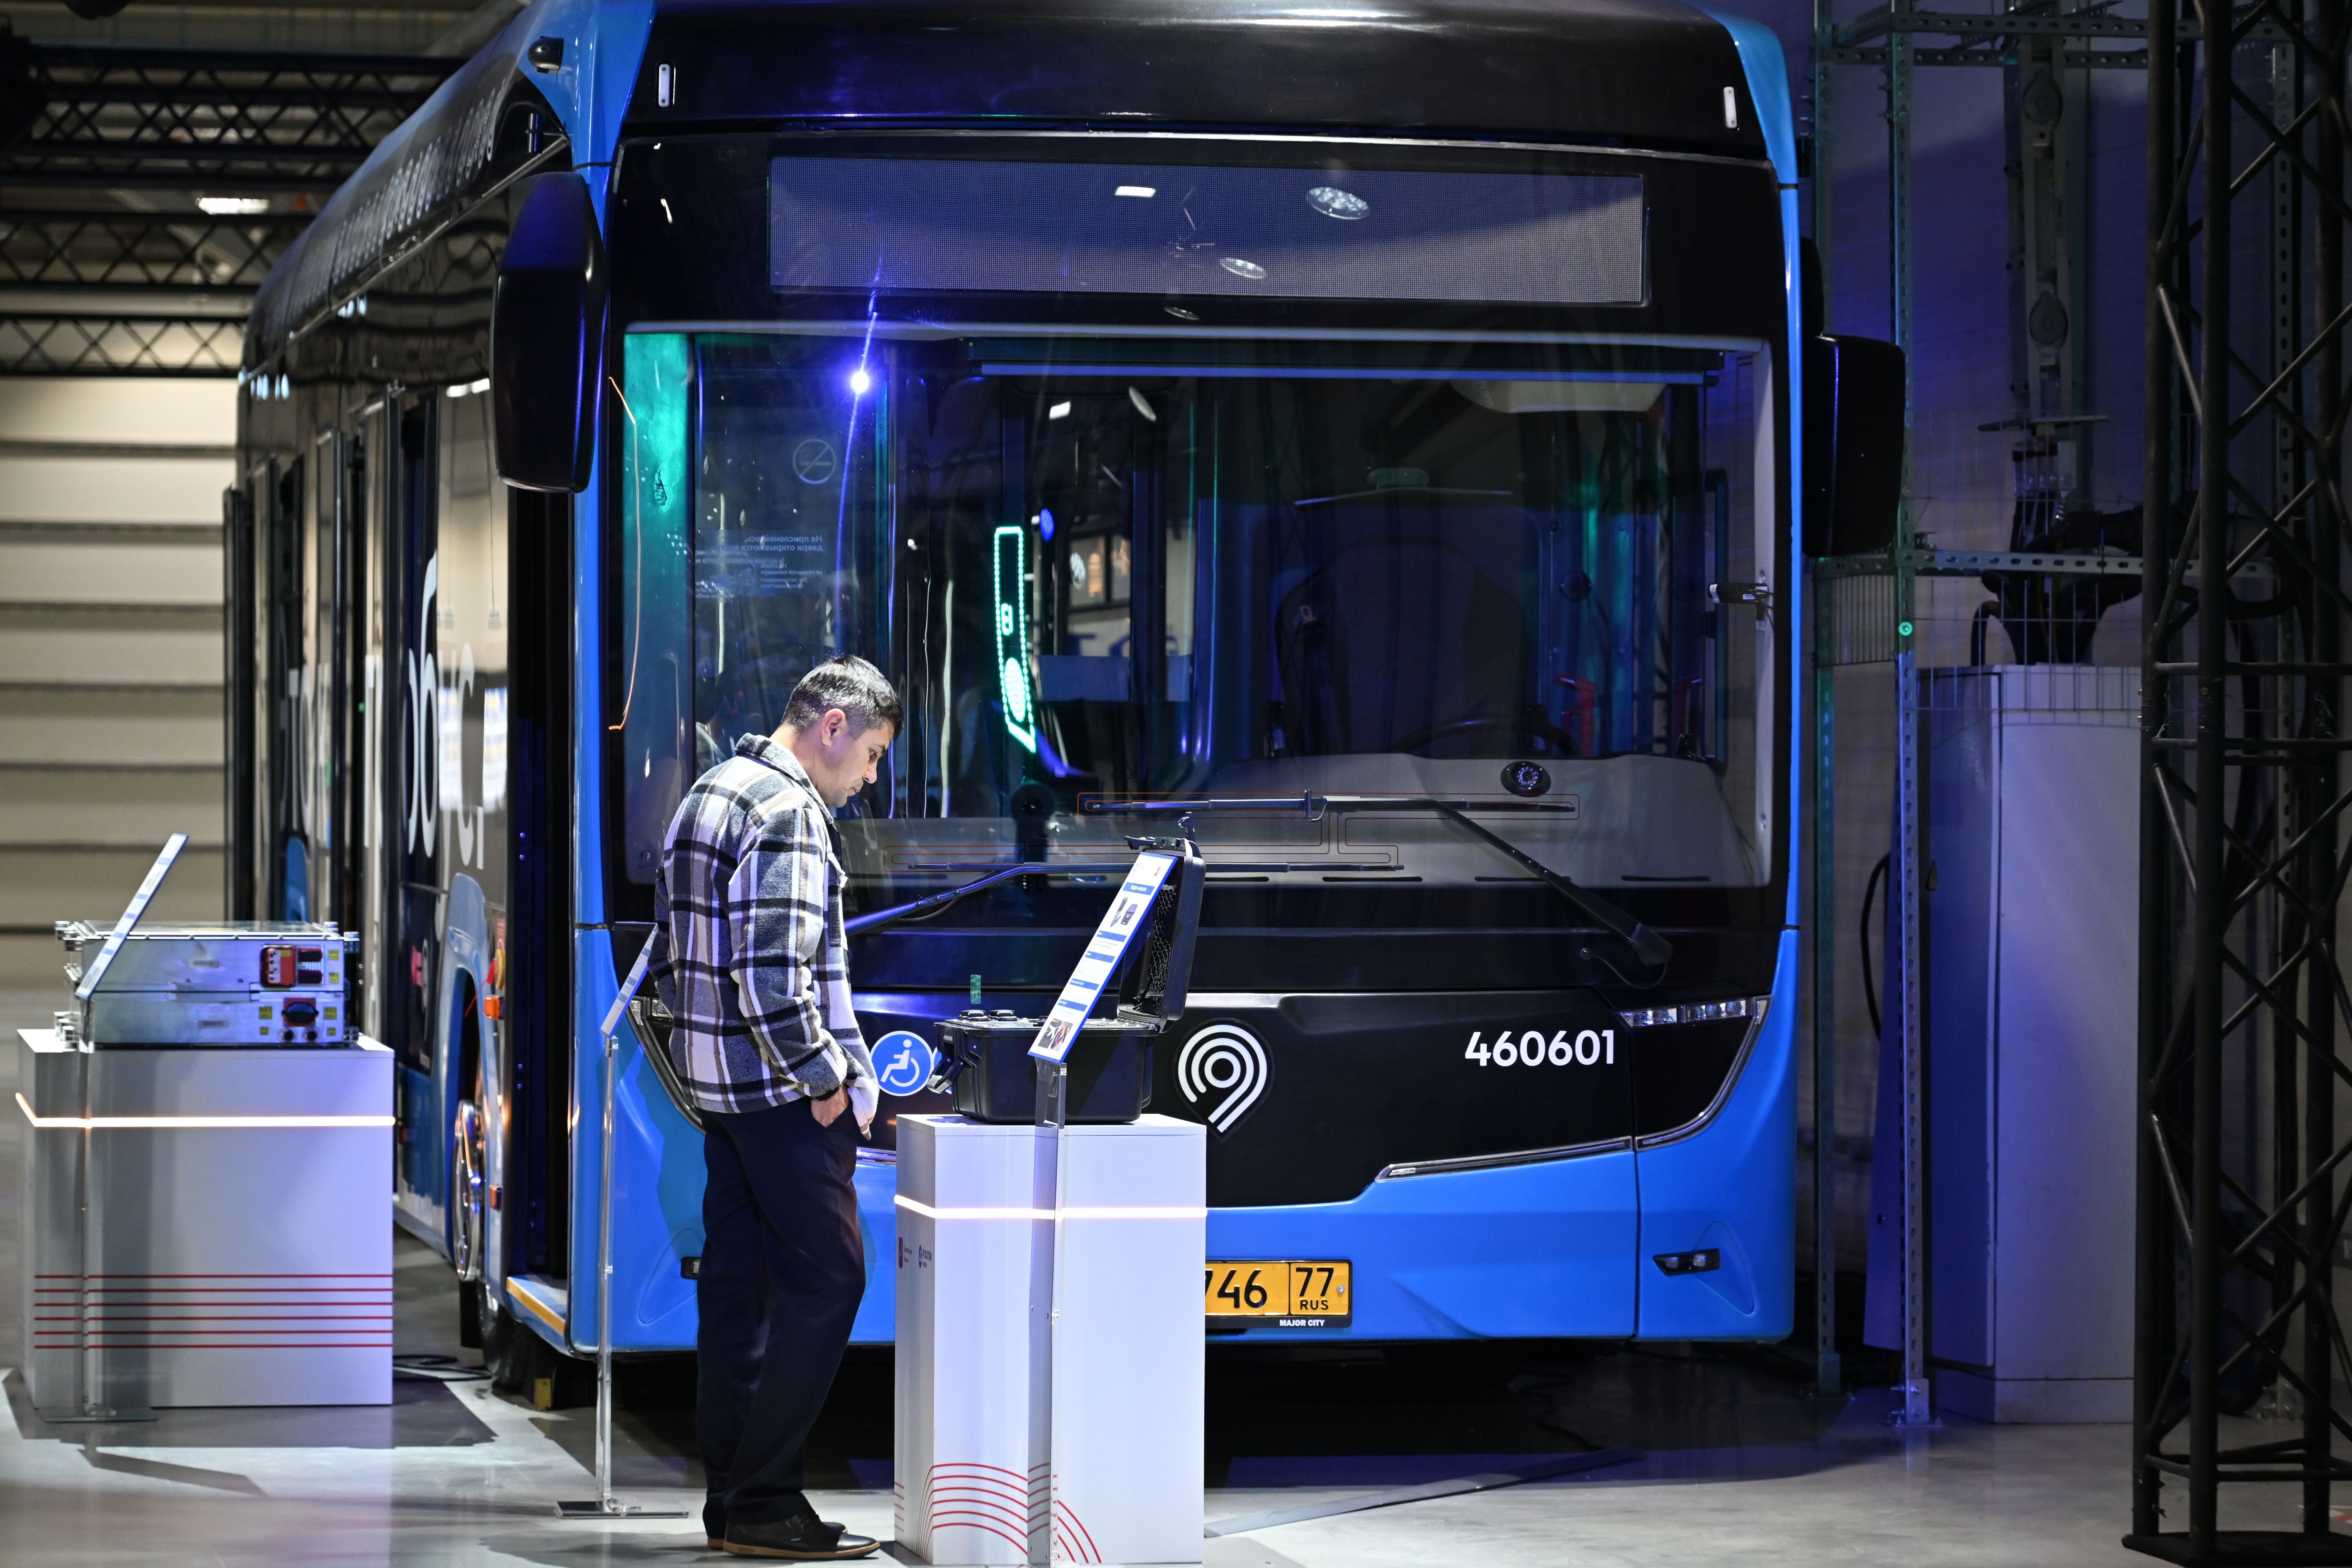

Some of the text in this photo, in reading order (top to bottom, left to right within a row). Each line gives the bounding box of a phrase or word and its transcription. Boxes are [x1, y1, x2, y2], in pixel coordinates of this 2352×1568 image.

[1465, 1030, 1614, 1067] 460601
[1296, 1267, 1334, 1297] 77
[1300, 1299, 1329, 1310] RUS
